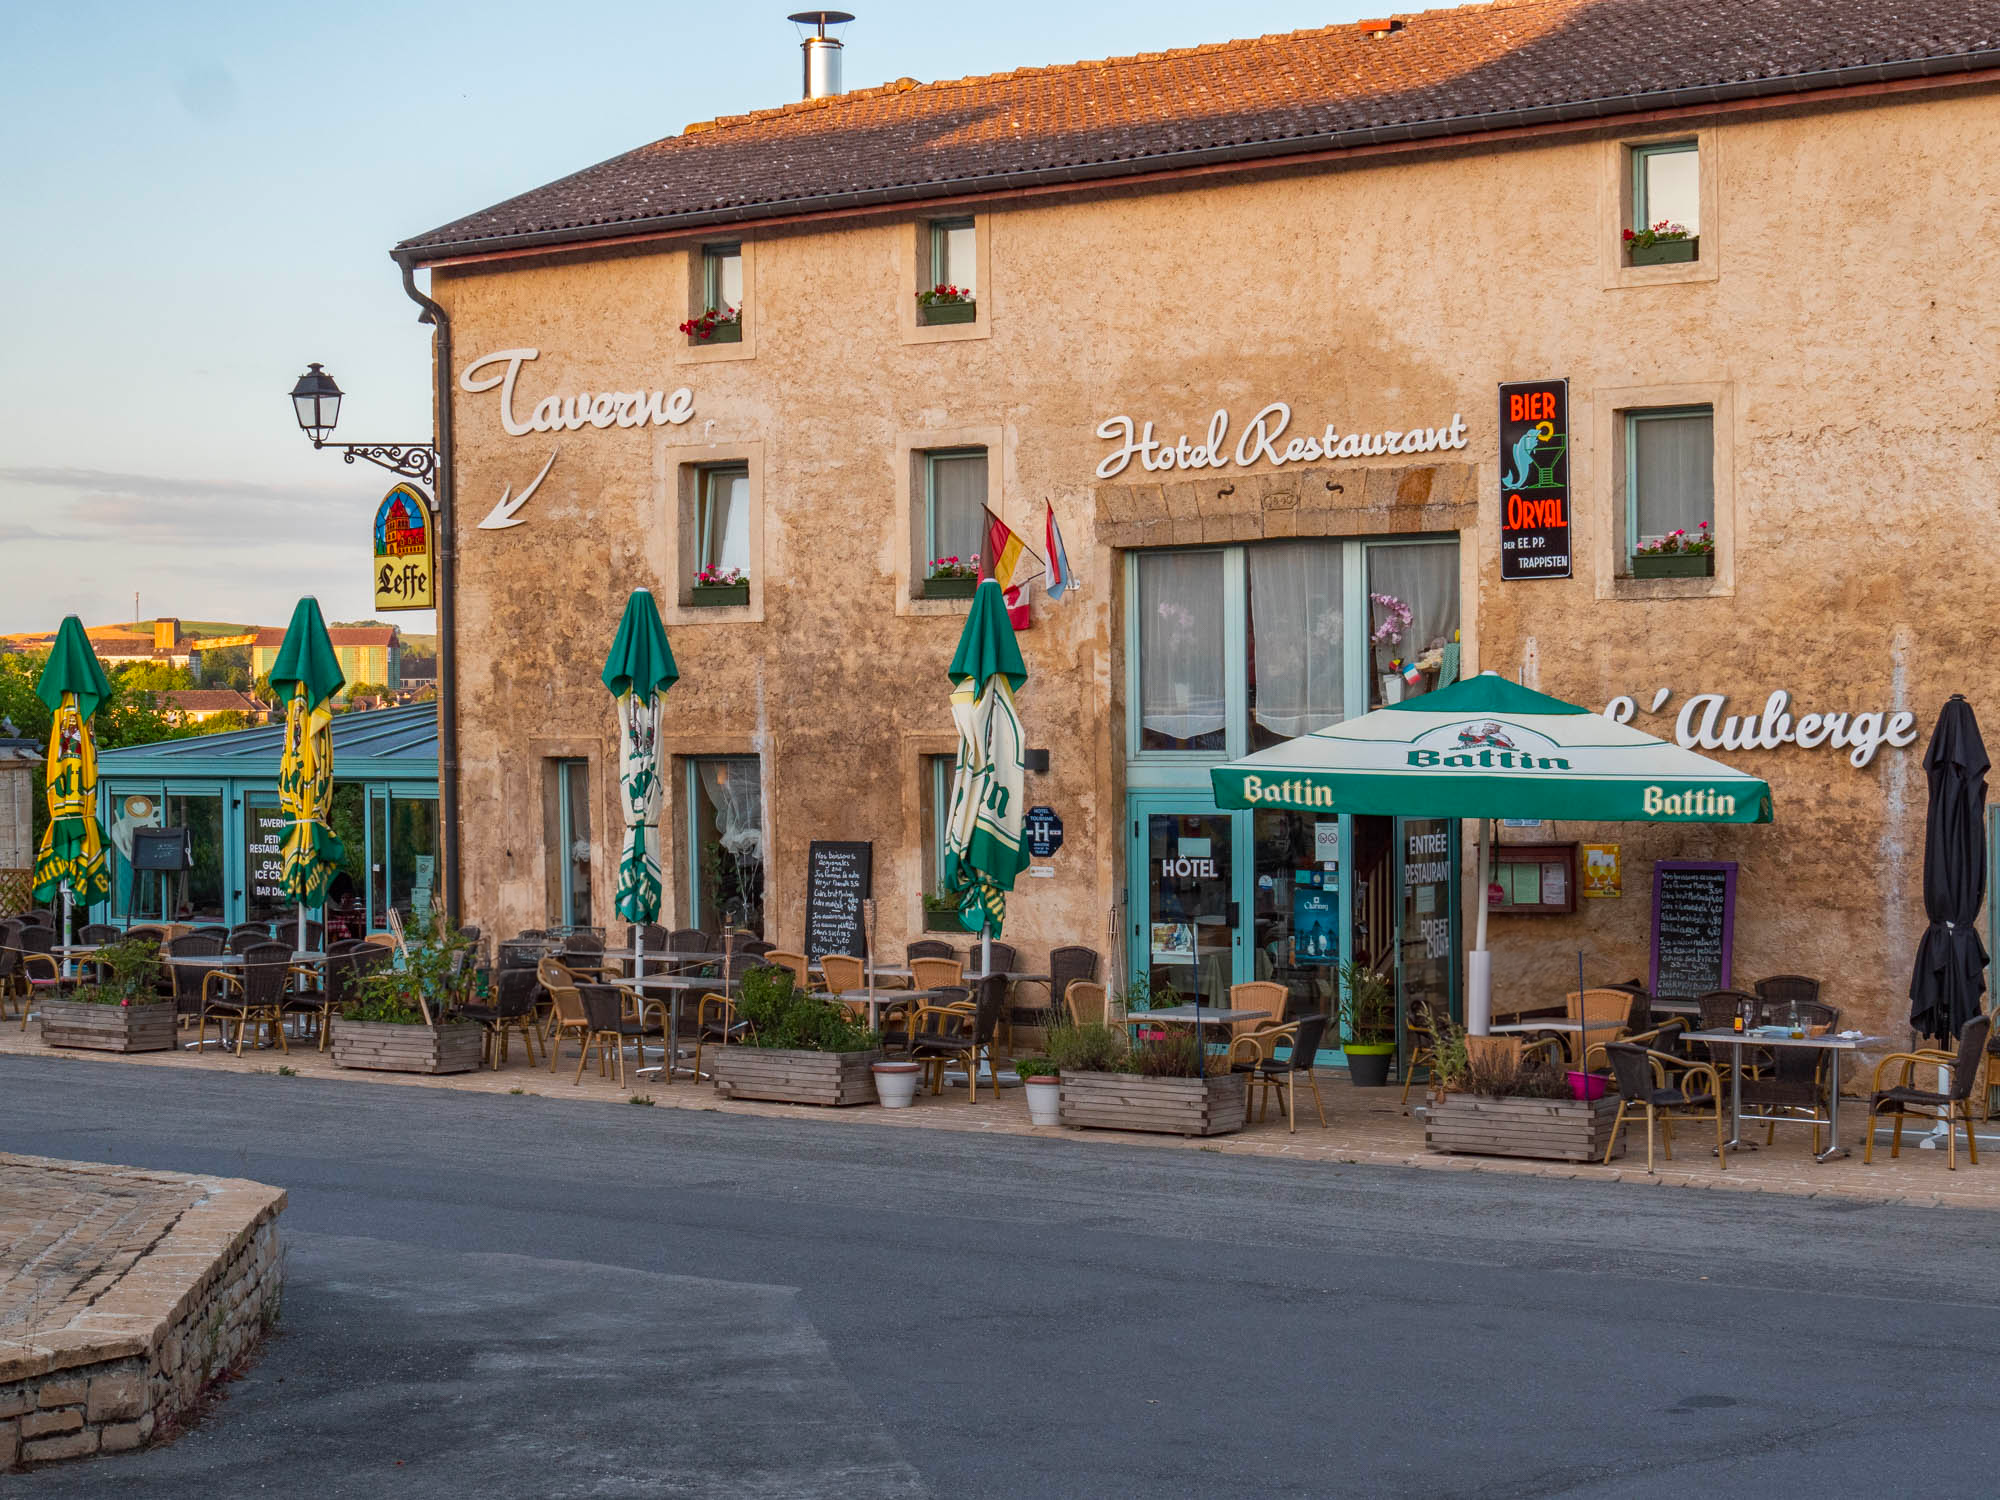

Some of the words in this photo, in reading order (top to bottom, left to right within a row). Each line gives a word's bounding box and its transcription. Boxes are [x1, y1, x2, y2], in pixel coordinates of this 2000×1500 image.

[460, 348, 694, 436] Taverne
[1510, 391, 1556, 422] BIER
[1095, 408, 1229, 479] Hotel
[1235, 402, 1468, 466] Restaurant
[1504, 541, 1515, 550] DER
[1518, 555, 1568, 569] TRAPPISTEN
[376, 563, 428, 600] Leffe
[1407, 749, 1574, 771] Battin
[1243, 774, 1334, 807] Battin
[1643, 786, 1736, 817] Battin
[259, 818, 287, 828] TAVERN
[1034, 822, 1050, 842] H
[249, 844, 281, 854] RESTAUR
[1409, 829, 1447, 855] ENTRÉE
[255, 870, 268, 879] ICE
[262, 860, 282, 870] GLAC
[1162, 854, 1218, 878] HÔTEL
[1405, 861, 1450, 884] RESTAURANT
[256, 886, 271, 896] BAR
